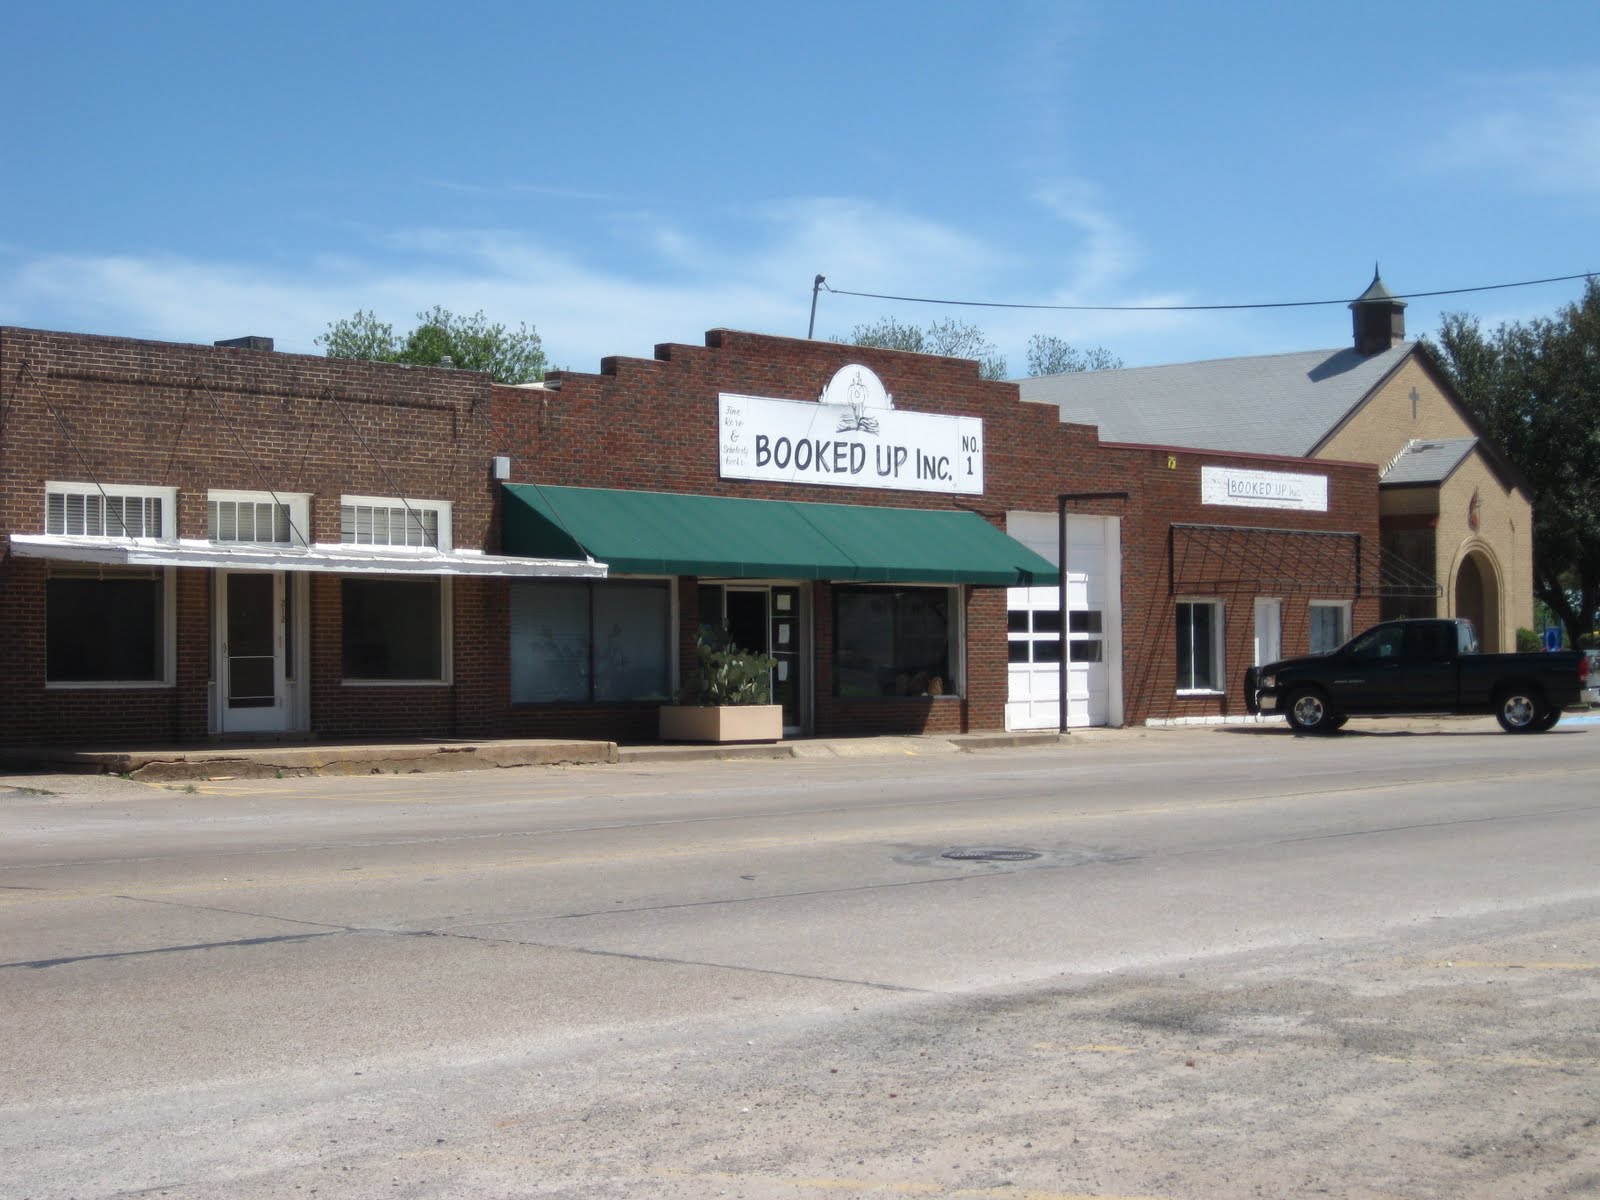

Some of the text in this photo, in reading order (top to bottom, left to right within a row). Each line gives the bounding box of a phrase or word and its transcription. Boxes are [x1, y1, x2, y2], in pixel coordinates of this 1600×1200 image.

[730, 430, 739, 442] &
[962, 435, 980, 454] NO.
[755, 434, 866, 475] BOOKED
[876, 444, 908, 478] UP
[966, 456, 974, 475] 1
[1231, 480, 1272, 496] BOOKED
[1275, 484, 1287, 497] UP
